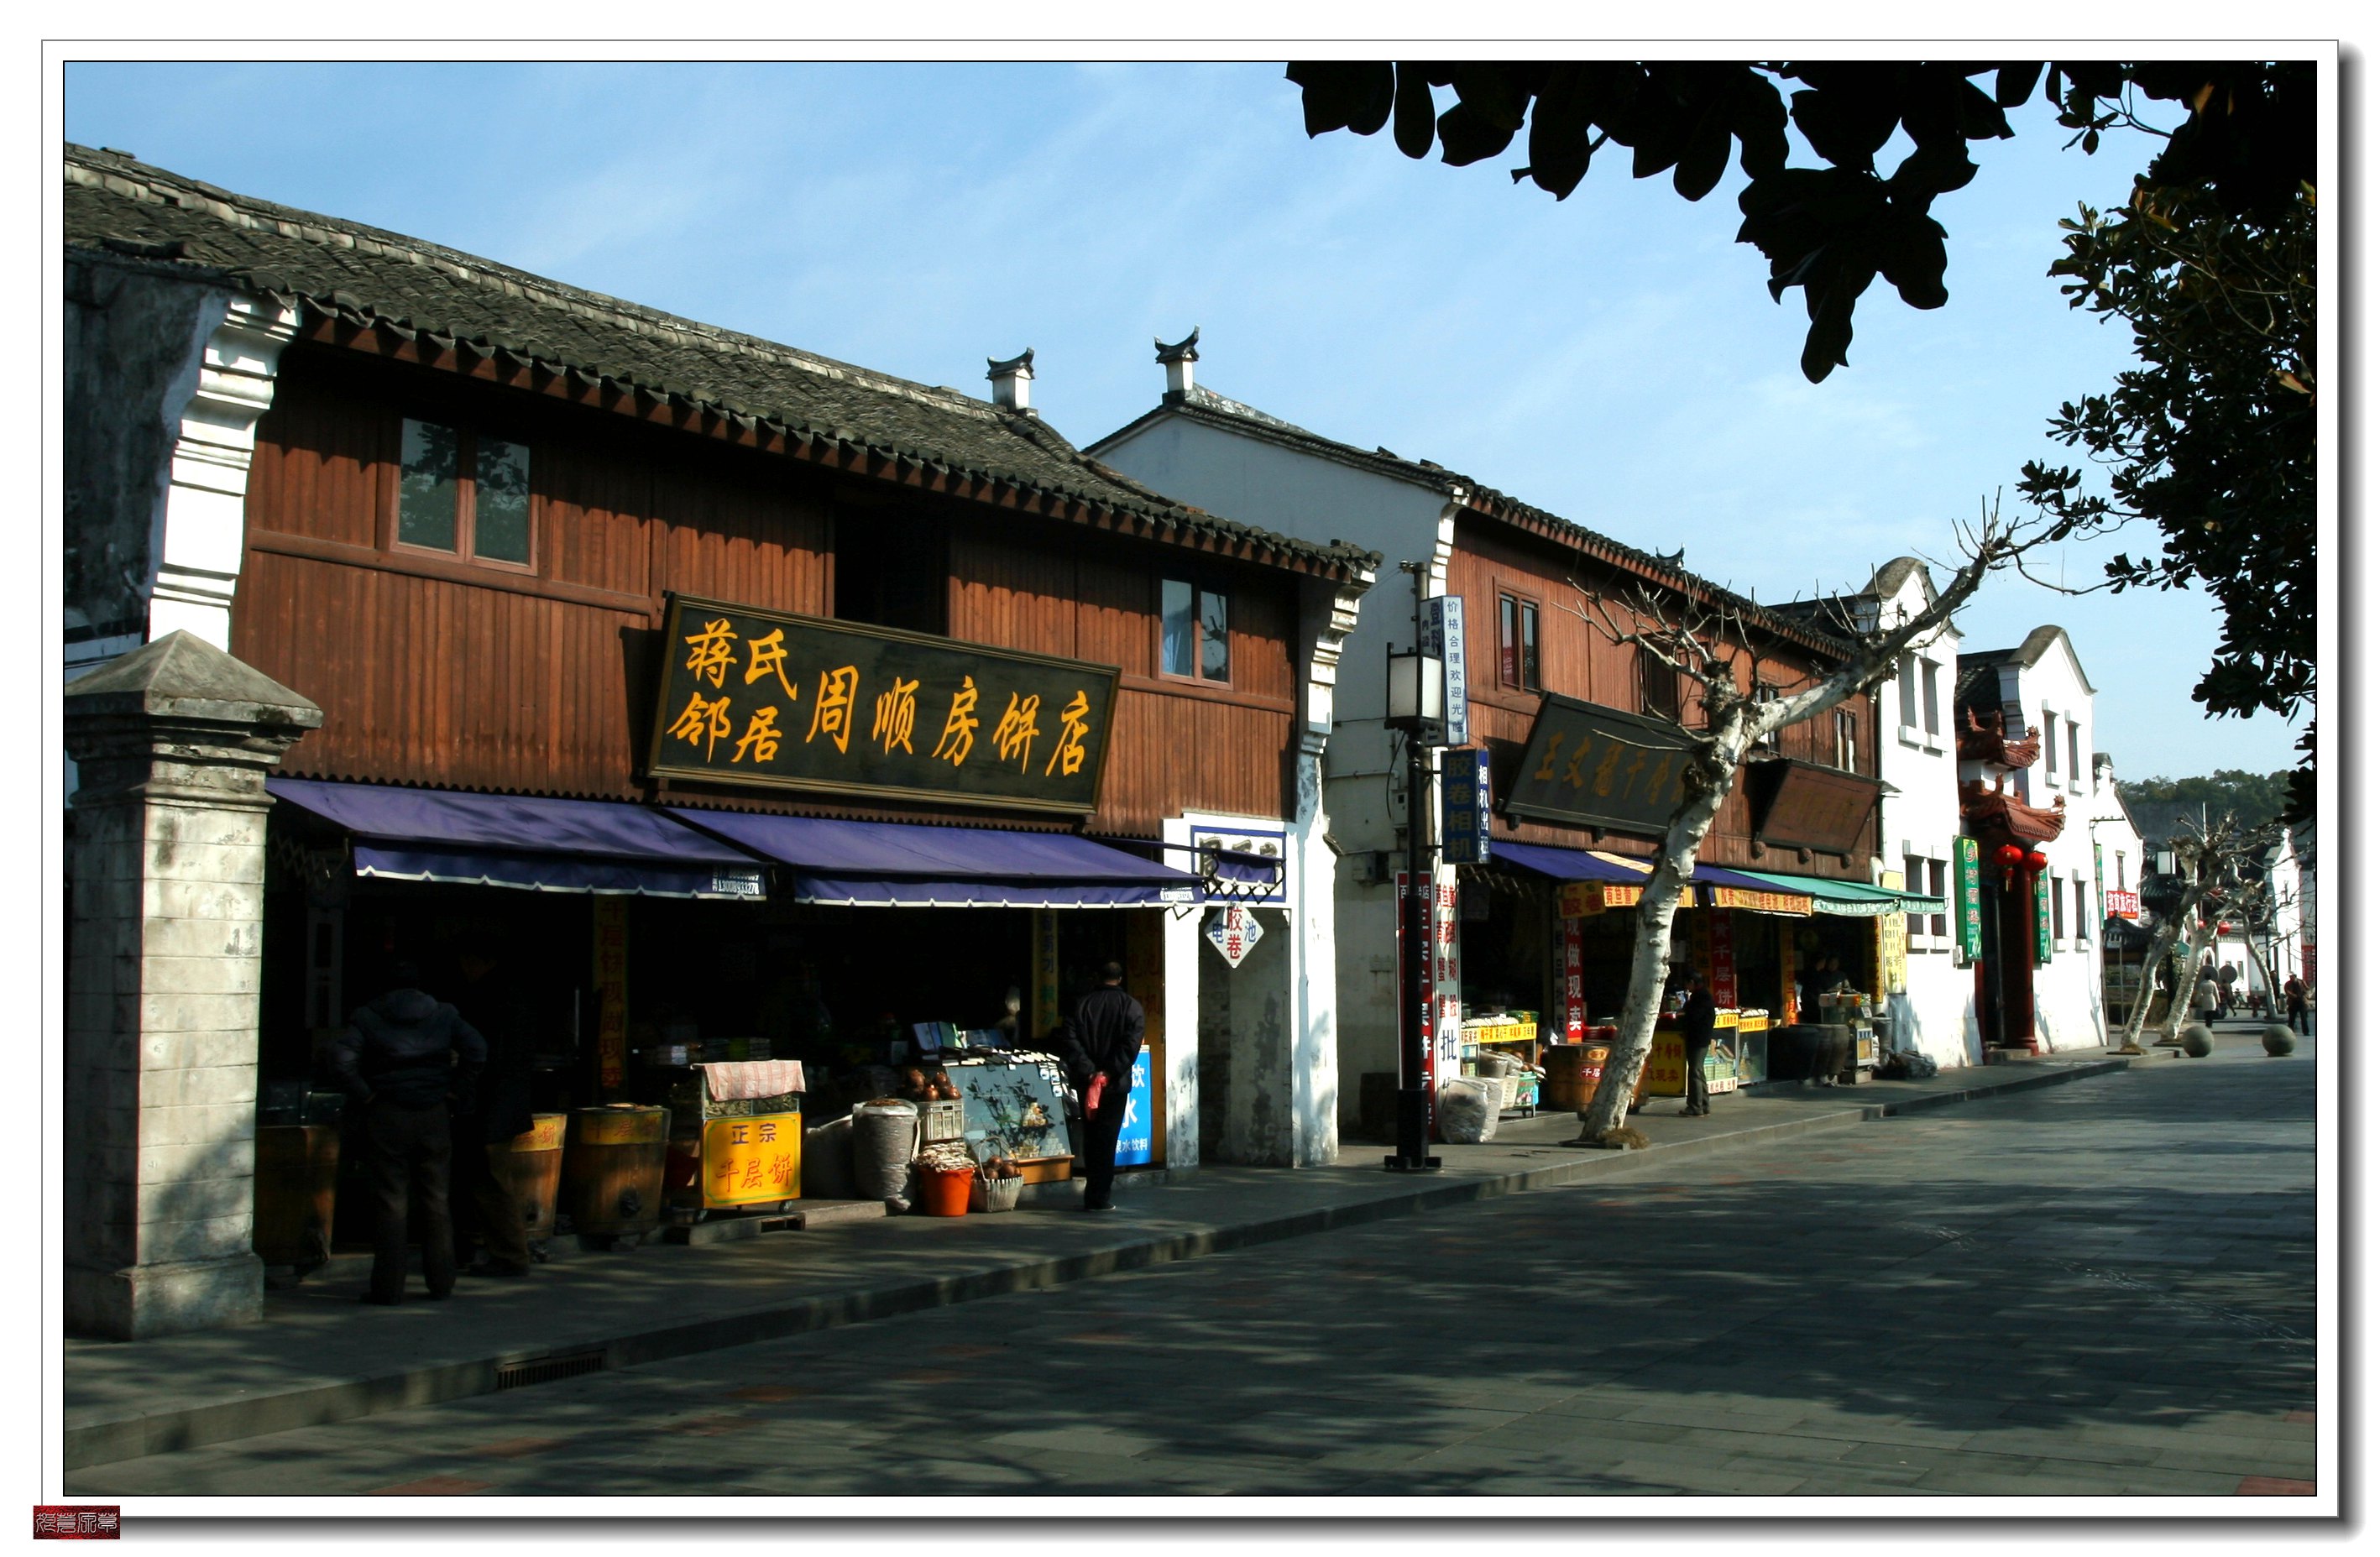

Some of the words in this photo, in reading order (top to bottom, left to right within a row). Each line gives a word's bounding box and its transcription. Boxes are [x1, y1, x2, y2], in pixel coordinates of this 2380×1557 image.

[684, 618, 798, 701] 蒋氏
[1447, 601, 1463, 732] 价格合理欢迎光临
[667, 691, 782, 763] 邻居
[806, 665, 1089, 776] 周顺房饼店
[1446, 756, 1472, 859] 胶卷相机
[1212, 920, 1257, 943] 电池
[1227, 907, 1242, 959] 胶卷
[731, 1123, 776, 1145] 正宗
[715, 1153, 792, 1193] 千层饼
